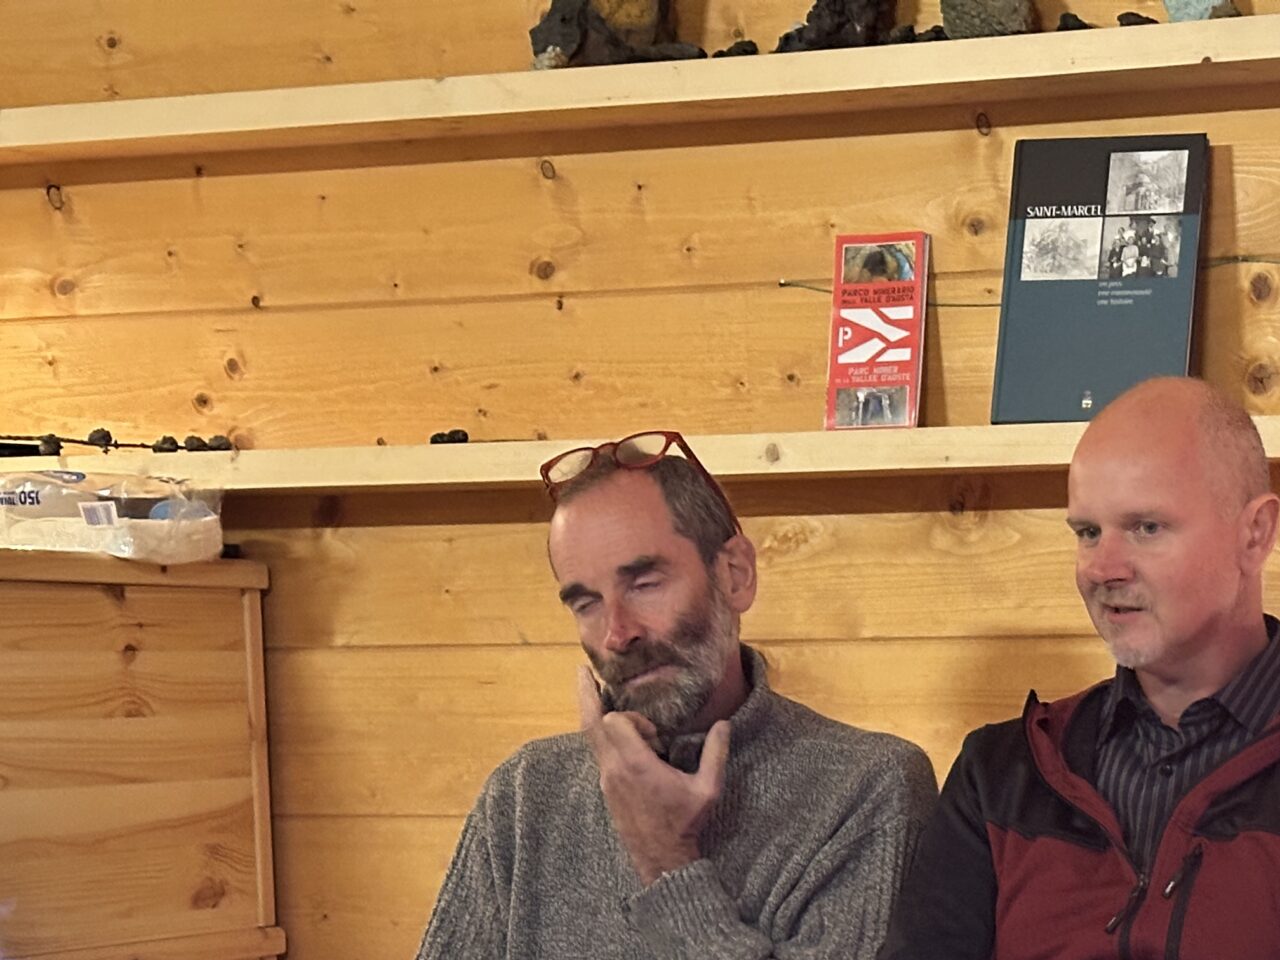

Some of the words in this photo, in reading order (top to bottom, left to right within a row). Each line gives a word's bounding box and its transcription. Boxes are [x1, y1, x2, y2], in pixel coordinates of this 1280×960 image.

[1026, 204, 1103, 217] SAINT-MARCEL
[841, 288, 870, 297] PARCO
[19, 490, 41, 506] 150
